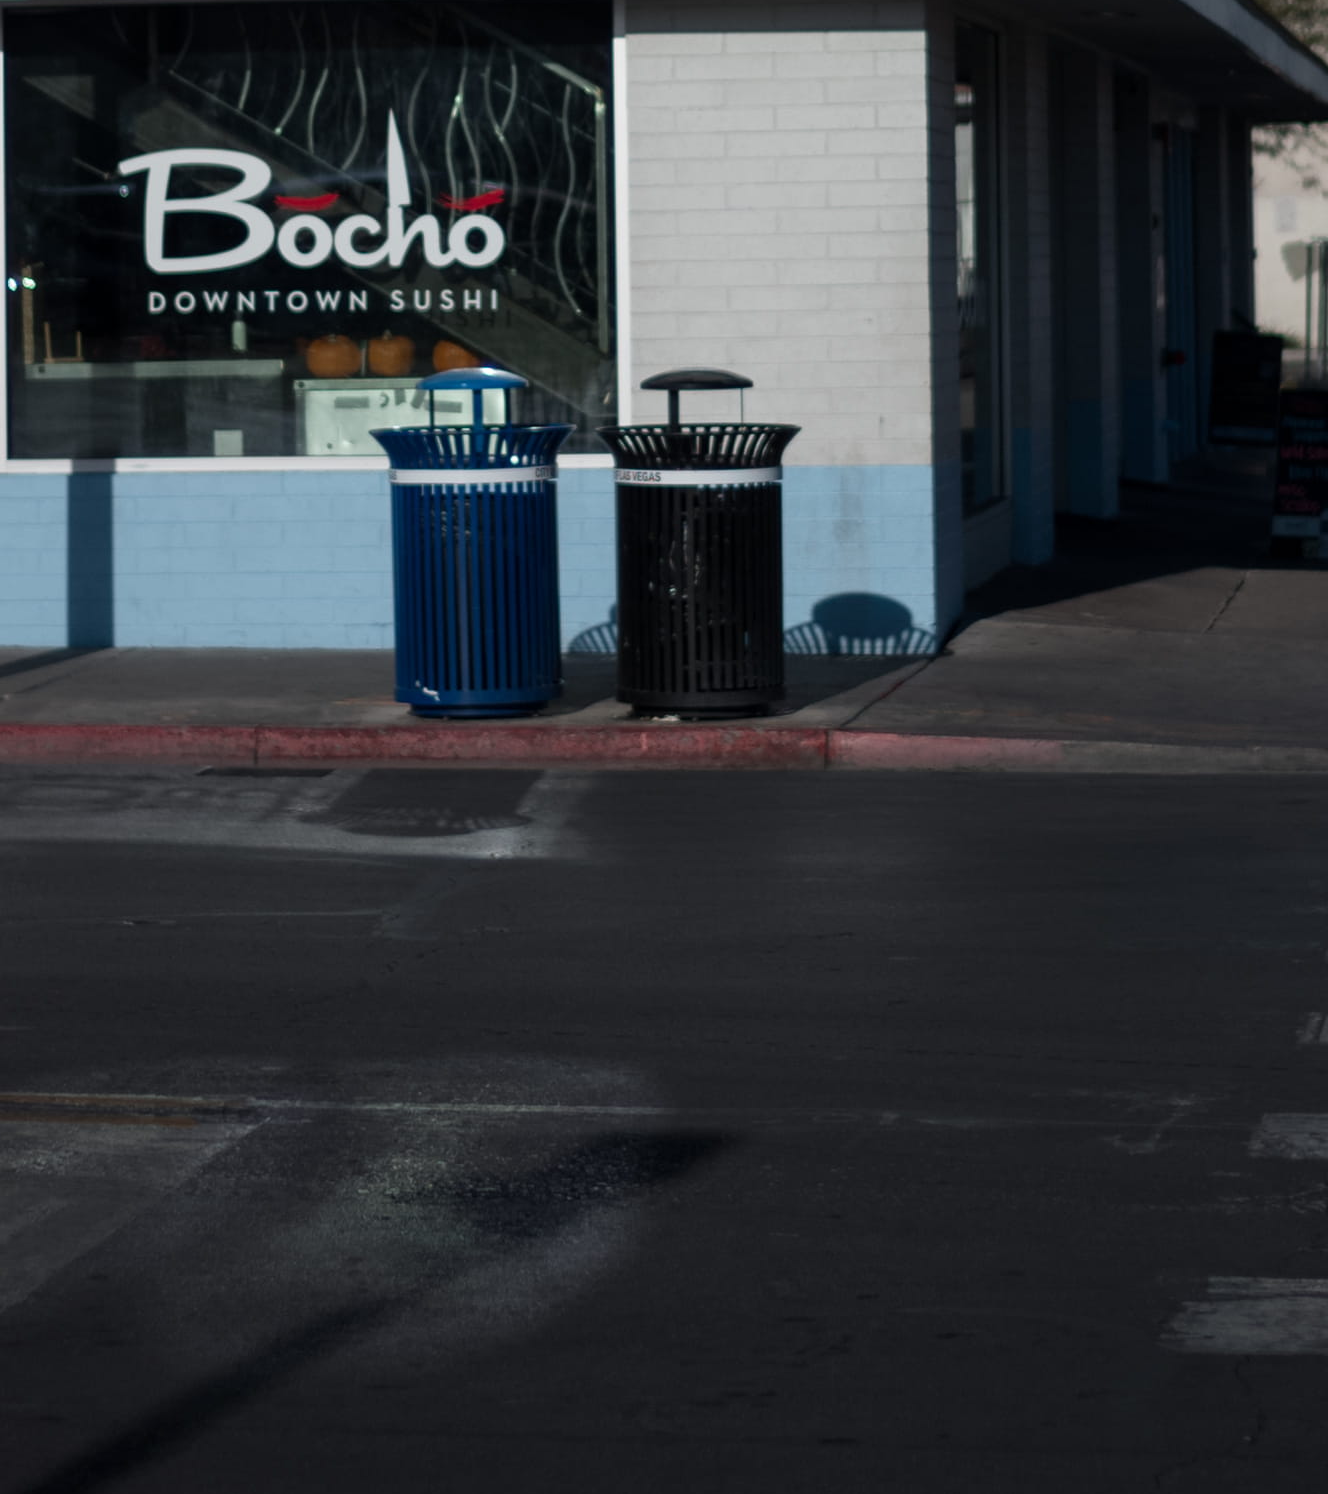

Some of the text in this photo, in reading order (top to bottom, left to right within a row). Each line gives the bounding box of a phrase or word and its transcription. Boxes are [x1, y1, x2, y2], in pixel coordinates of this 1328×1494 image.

[117, 107, 506, 276] Bocho
[147, 287, 499, 315] DOWNTOWN SUSHI
[632, 471, 662, 482] VEGAS
